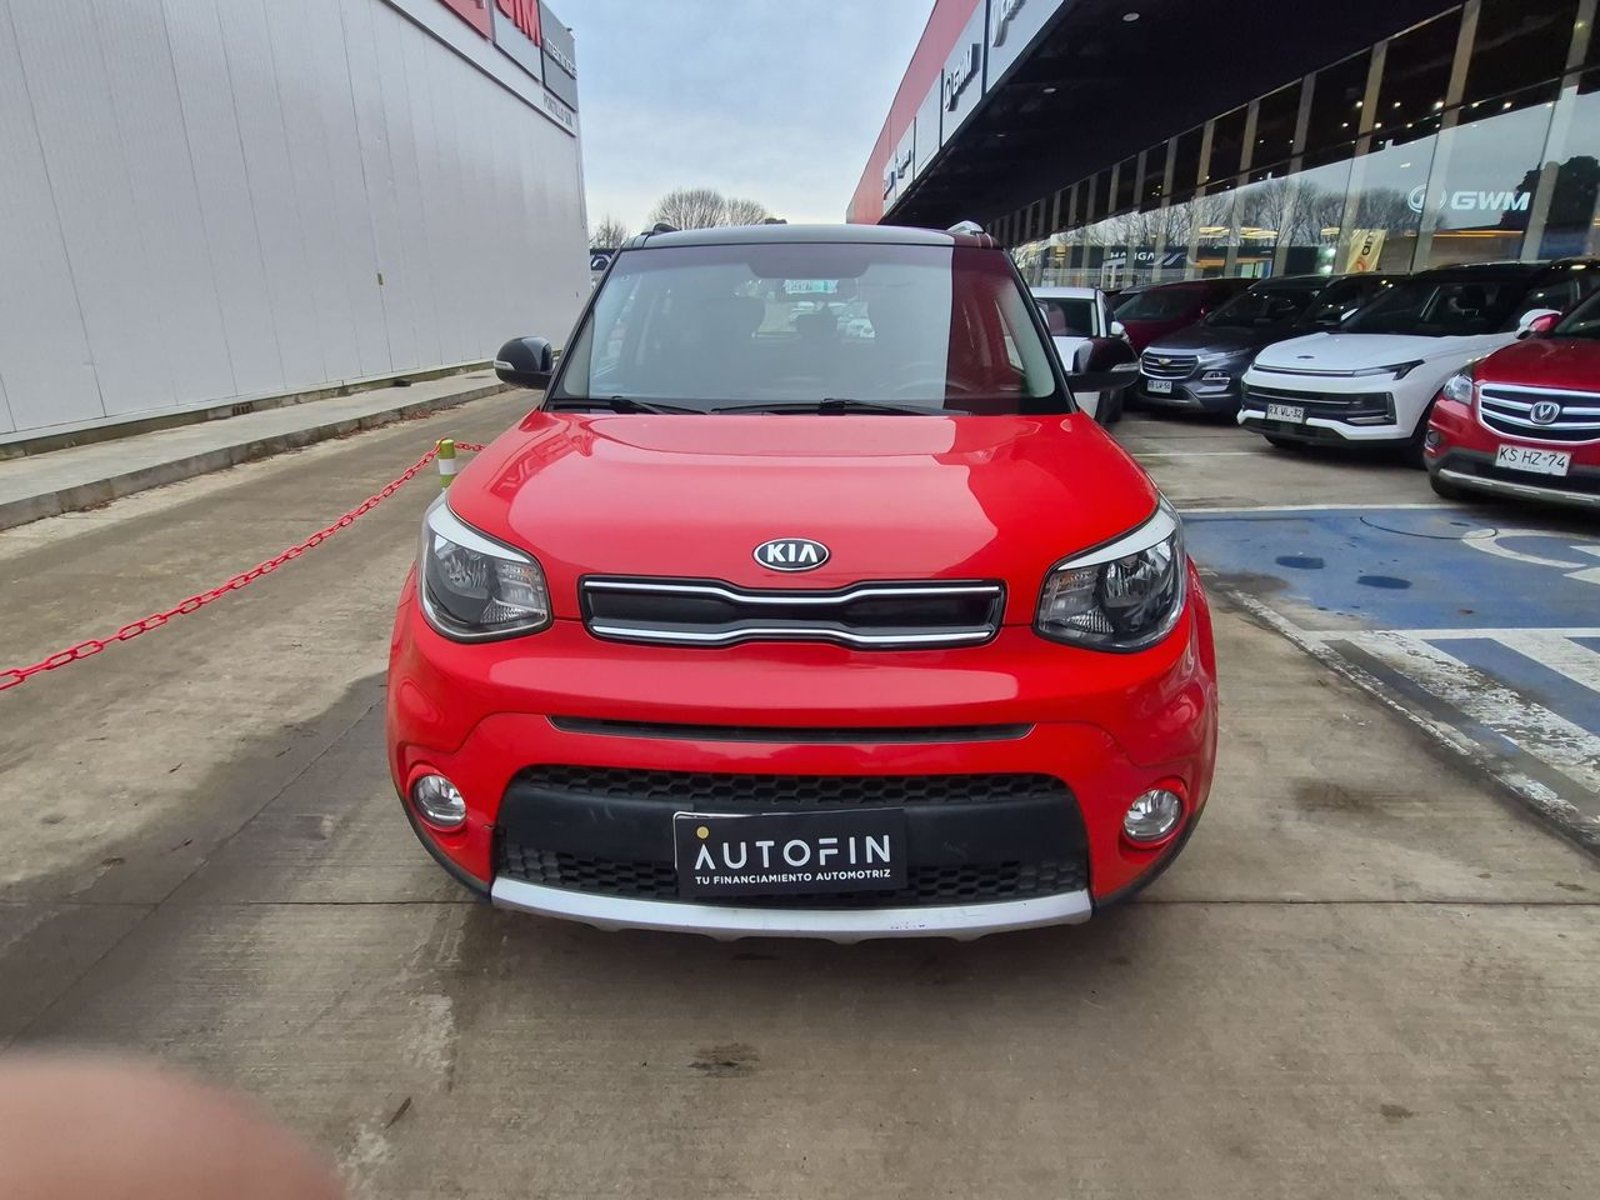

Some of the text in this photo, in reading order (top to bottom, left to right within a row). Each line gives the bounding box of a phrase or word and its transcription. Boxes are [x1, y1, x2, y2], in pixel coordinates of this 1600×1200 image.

[1451, 191, 1531, 211] GWM
[767, 543, 818, 562] KIA
[695, 835, 891, 870] AUTOFIN
[695, 869, 891, 885] TU FINANCIAMIENTO AUTOMOTRIZ
